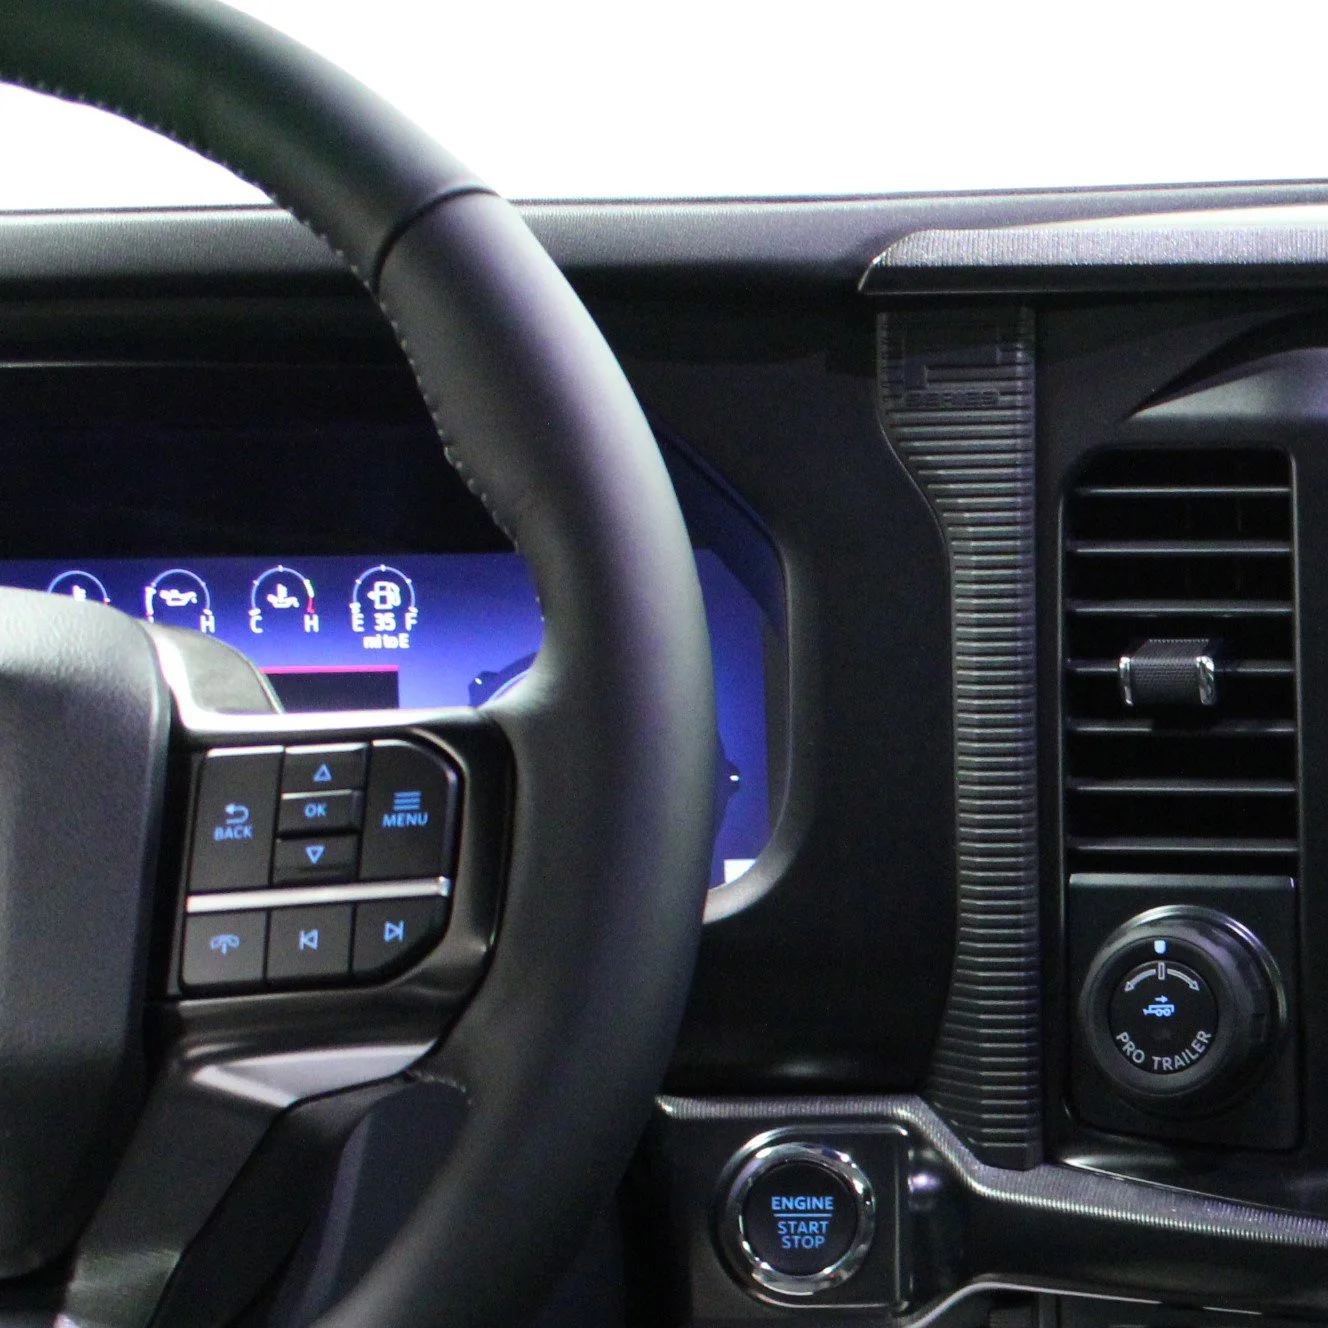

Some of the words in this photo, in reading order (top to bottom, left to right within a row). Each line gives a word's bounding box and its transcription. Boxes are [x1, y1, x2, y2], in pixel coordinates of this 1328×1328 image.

[250, 615, 265, 634] C
[304, 613, 321, 633] H
[373, 612, 397, 632] 35
[305, 804, 325, 817] OK
[383, 809, 428, 826] MENU
[215, 821, 251, 840] BACK
[1116, 1031, 1145, 1063] PRO
[1152, 1030, 1212, 1071] TRAILER
[772, 1196, 833, 1210] ENGINE
[778, 1221, 828, 1234] START
[782, 1235, 824, 1248] STOP
